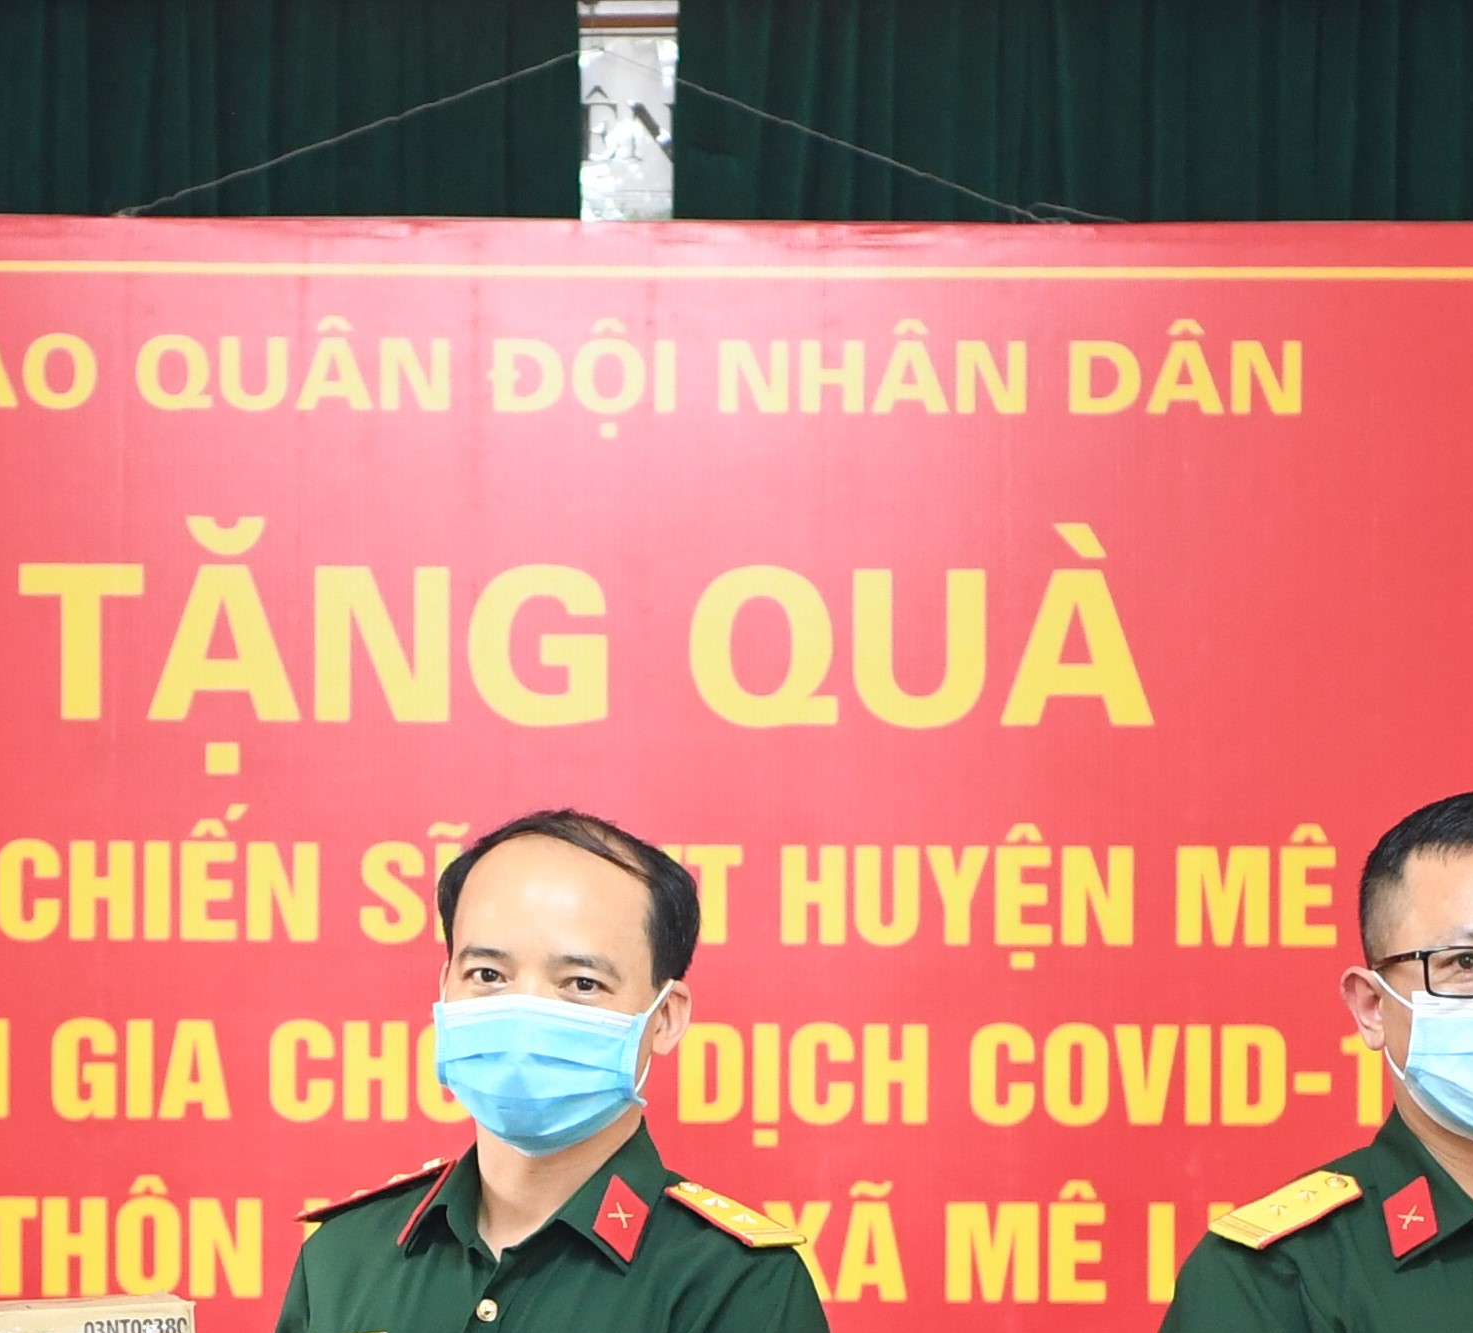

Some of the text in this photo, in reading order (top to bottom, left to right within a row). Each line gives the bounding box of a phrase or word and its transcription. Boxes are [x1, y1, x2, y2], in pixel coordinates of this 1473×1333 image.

[135, 316, 451, 413] QUÂN
[489, 318, 676, 438] ĐỘI
[719, 319, 1029, 415] NHÂN
[1068, 318, 1304, 415] DÂN
[17, 514, 1156, 776] TẶNG QUÀ
[778, 822, 1135, 970] HUYỆN
[1174, 822, 1338, 947] MÊ
[49, 1016, 233, 1121] GIA
[677, 1021, 930, 1148] DỊCH
[763, 1181, 908, 1304] XÃ
[944, 1180, 1108, 1303] MÊ
